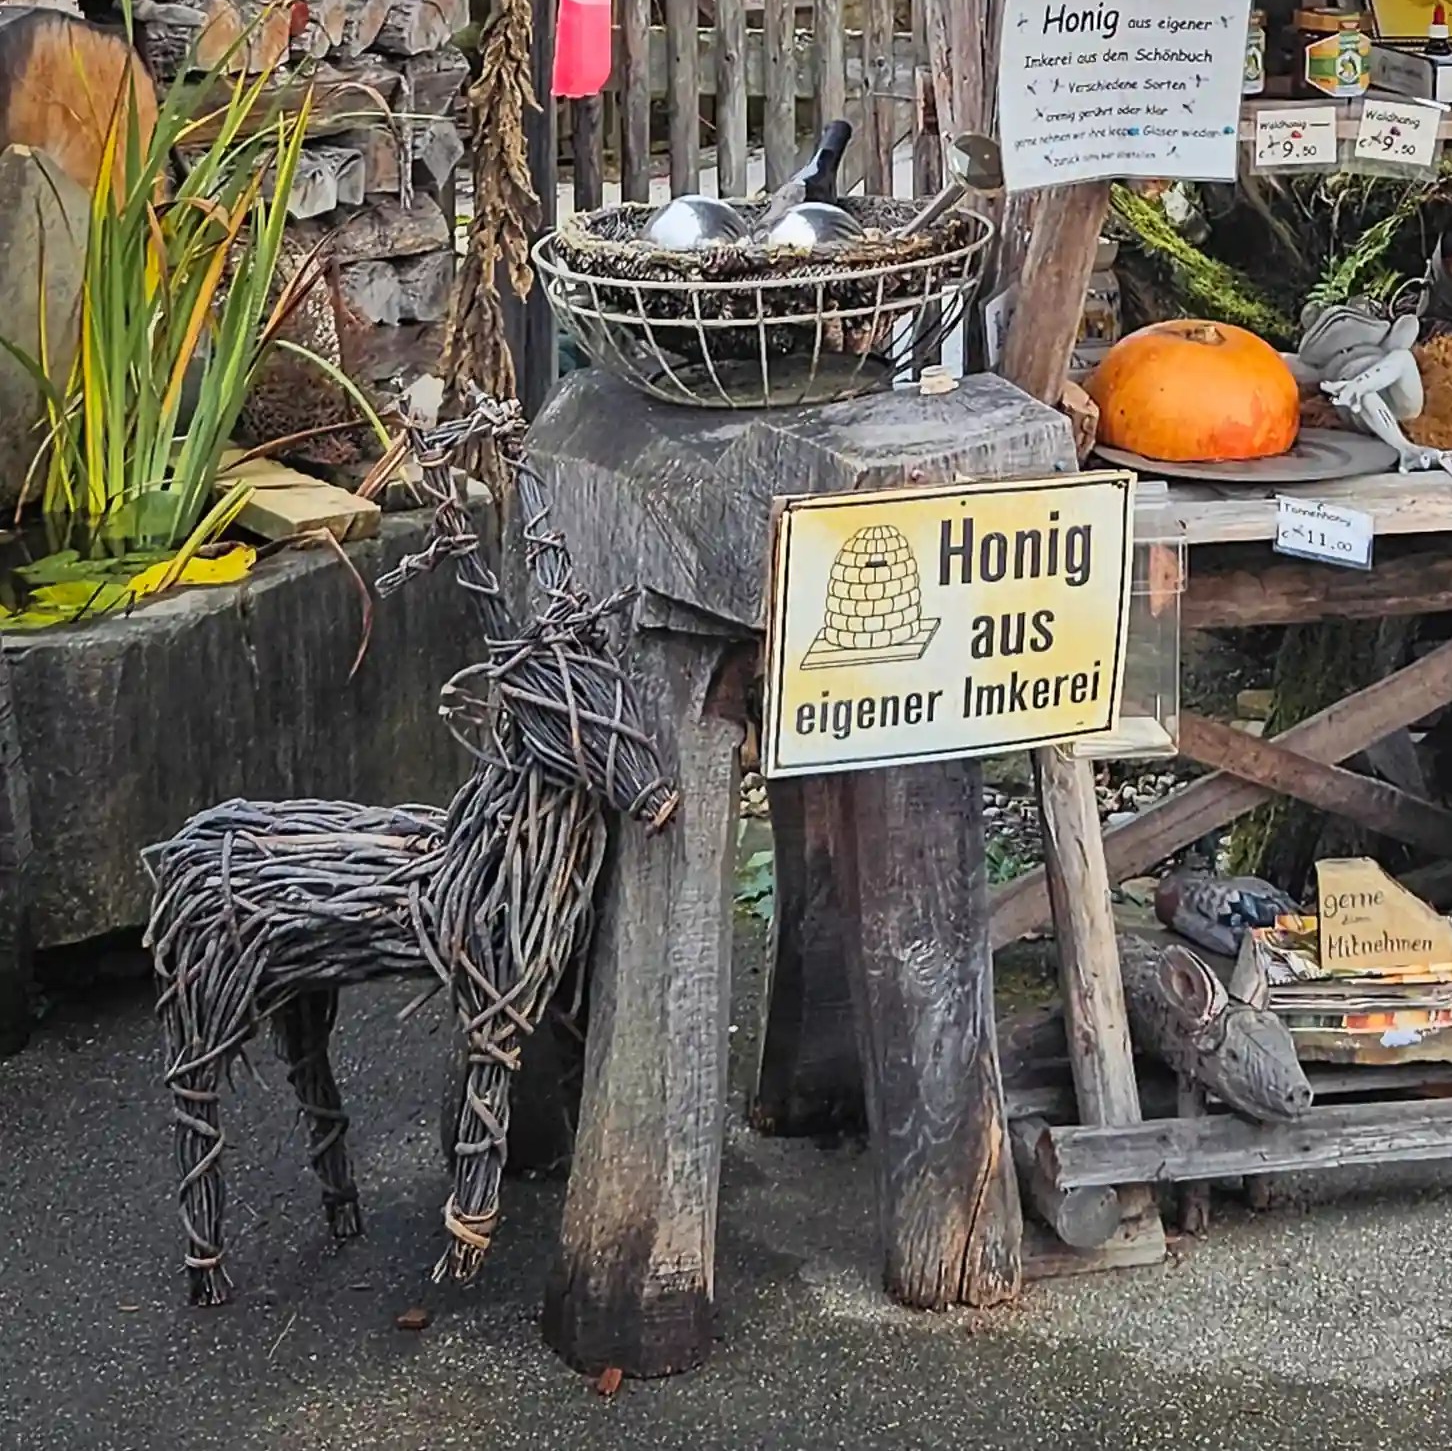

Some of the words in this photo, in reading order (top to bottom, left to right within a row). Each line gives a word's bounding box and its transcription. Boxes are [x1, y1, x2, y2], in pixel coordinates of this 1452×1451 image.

[1042, 1, 1120, 39] Honig
[1127, 18, 1152, 30] aus
[1157, 15, 1213, 34] eigener
[1024, 51, 1072, 69] Imkerei
[1076, 53, 1098, 65] aus
[1102, 48, 1129, 62] dem
[1134, 47, 1213, 64] Schönbuch
[1067, 78, 1139, 94] Verschiedene
[1143, 78, 1187, 91] Sorten
[1365, 108, 1421, 130] Waldhonig
[938, 510, 1092, 587] Honig
[1307, 529, 1353, 553] 11.00
[970, 608, 1056, 660] aus
[795, 690, 944, 740] eigener
[962, 660, 1101, 719] Imkerei
[1323, 889, 1384, 919] gerne
[1327, 929, 1433, 960] Mitnehmen
